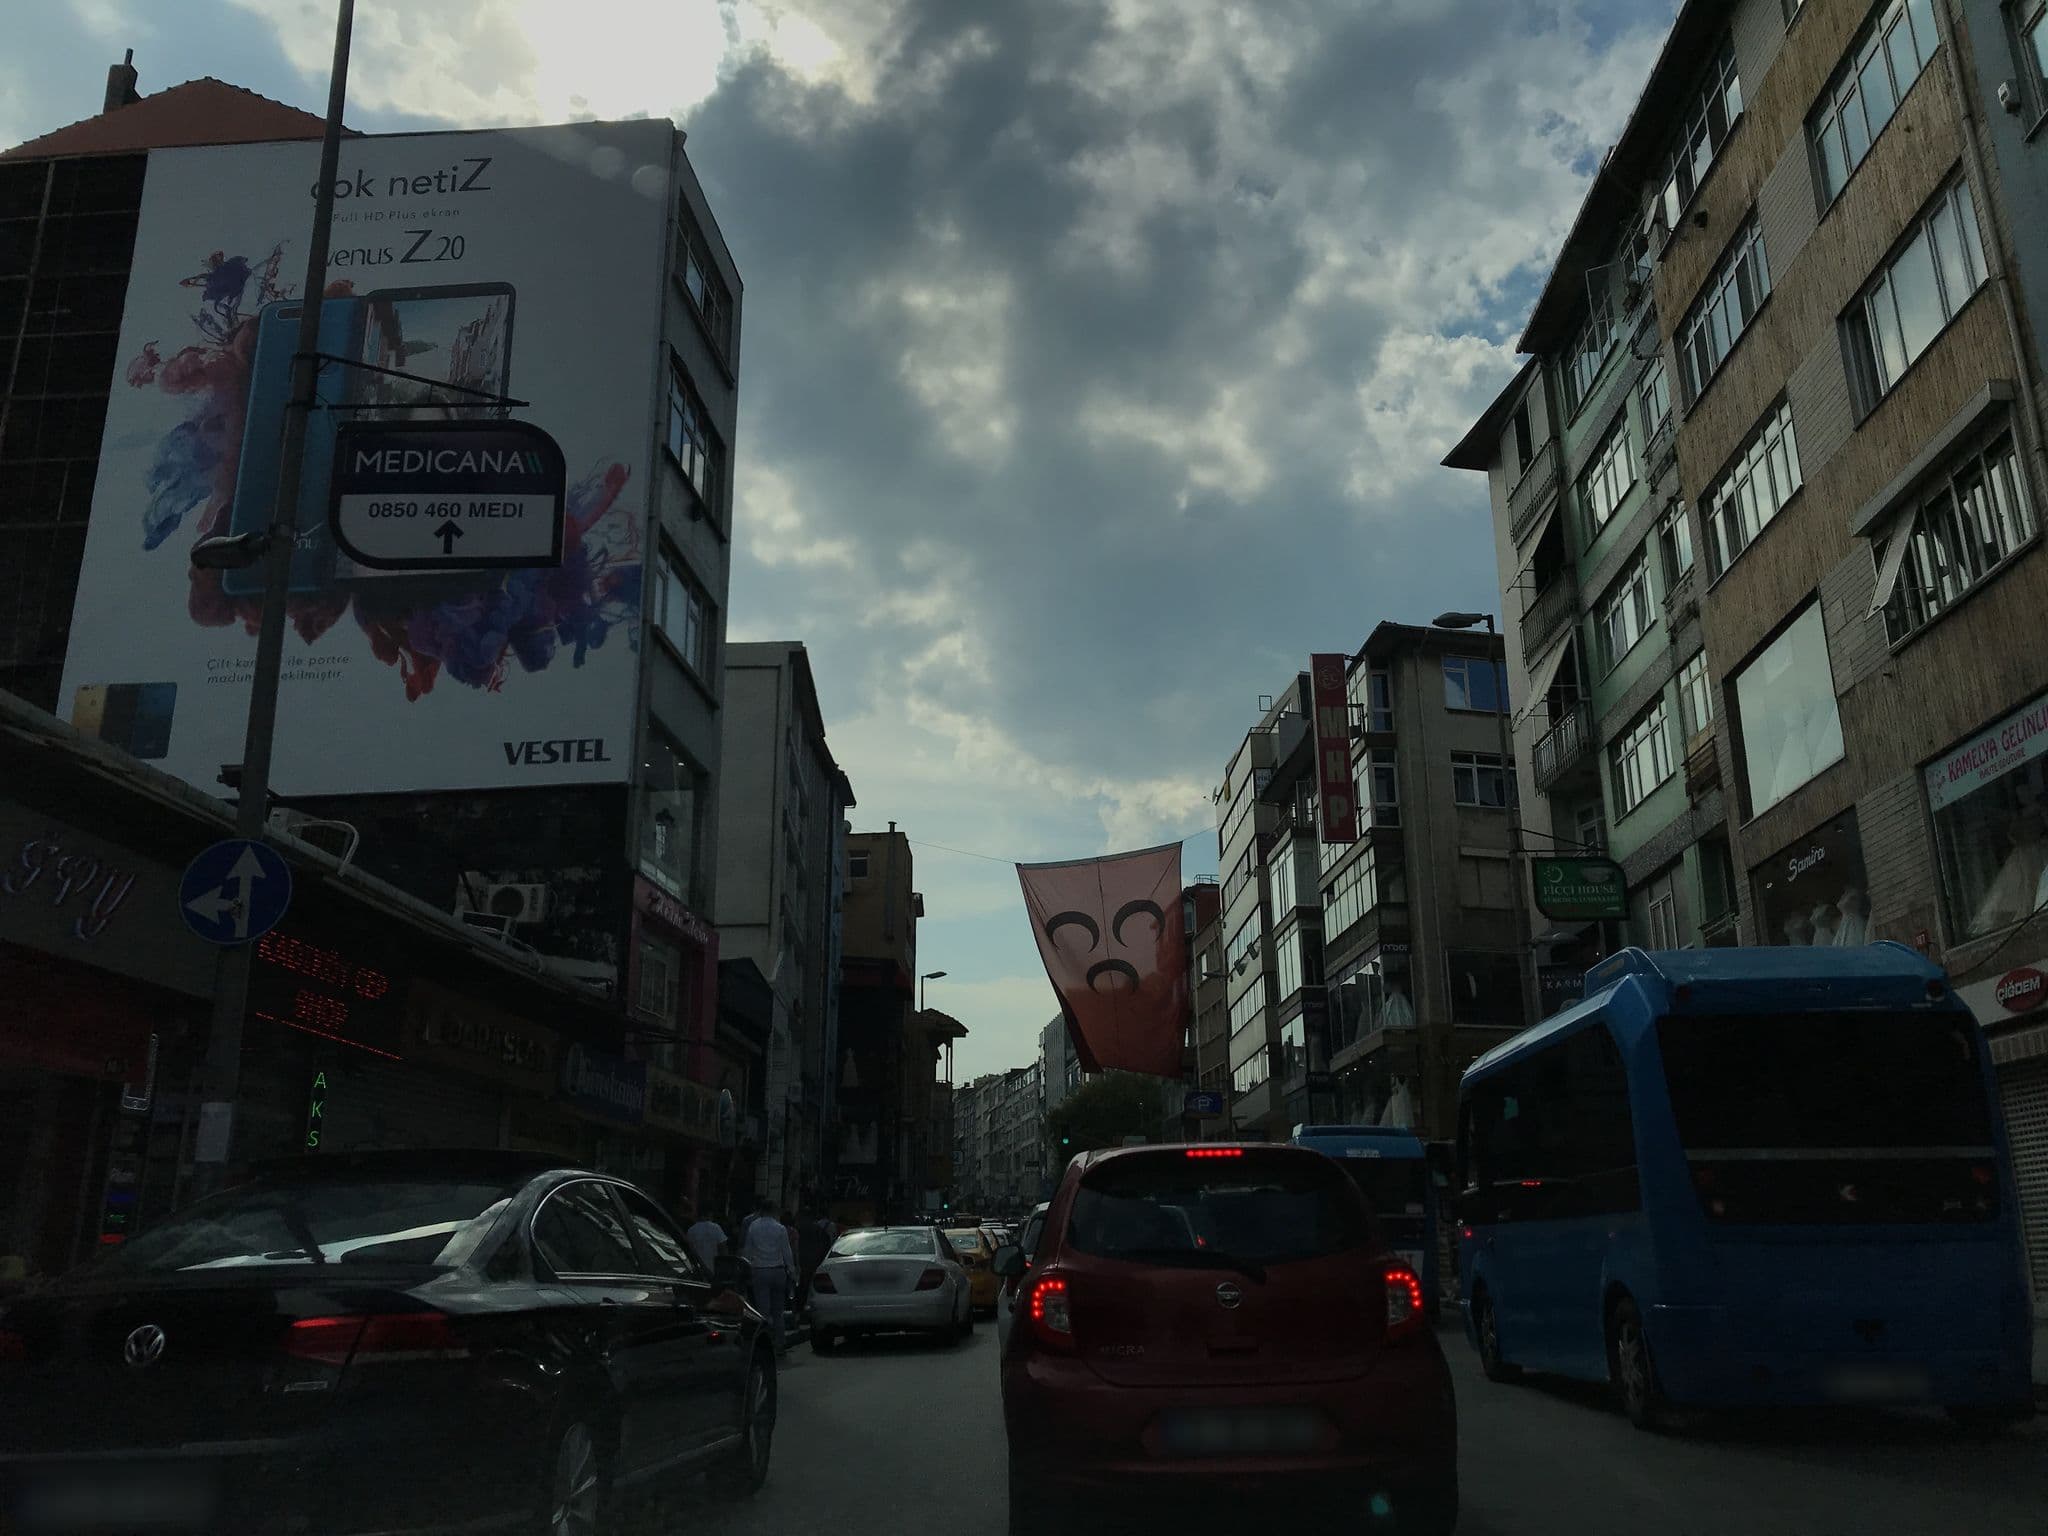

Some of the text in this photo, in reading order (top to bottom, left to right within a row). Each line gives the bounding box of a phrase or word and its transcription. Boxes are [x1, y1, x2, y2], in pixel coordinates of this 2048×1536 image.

[364, 211, 385, 221] HD
[388, 210, 416, 220] Plus
[422, 208, 461, 219] ekran
[354, 450, 526, 474] MEDICANA
[368, 502, 524, 518] 0850 460 MEDI
[207, 672, 252, 684] modun
[503, 738, 612, 766] VESTEL
[1947, 737, 1999, 783] KAMELYA
